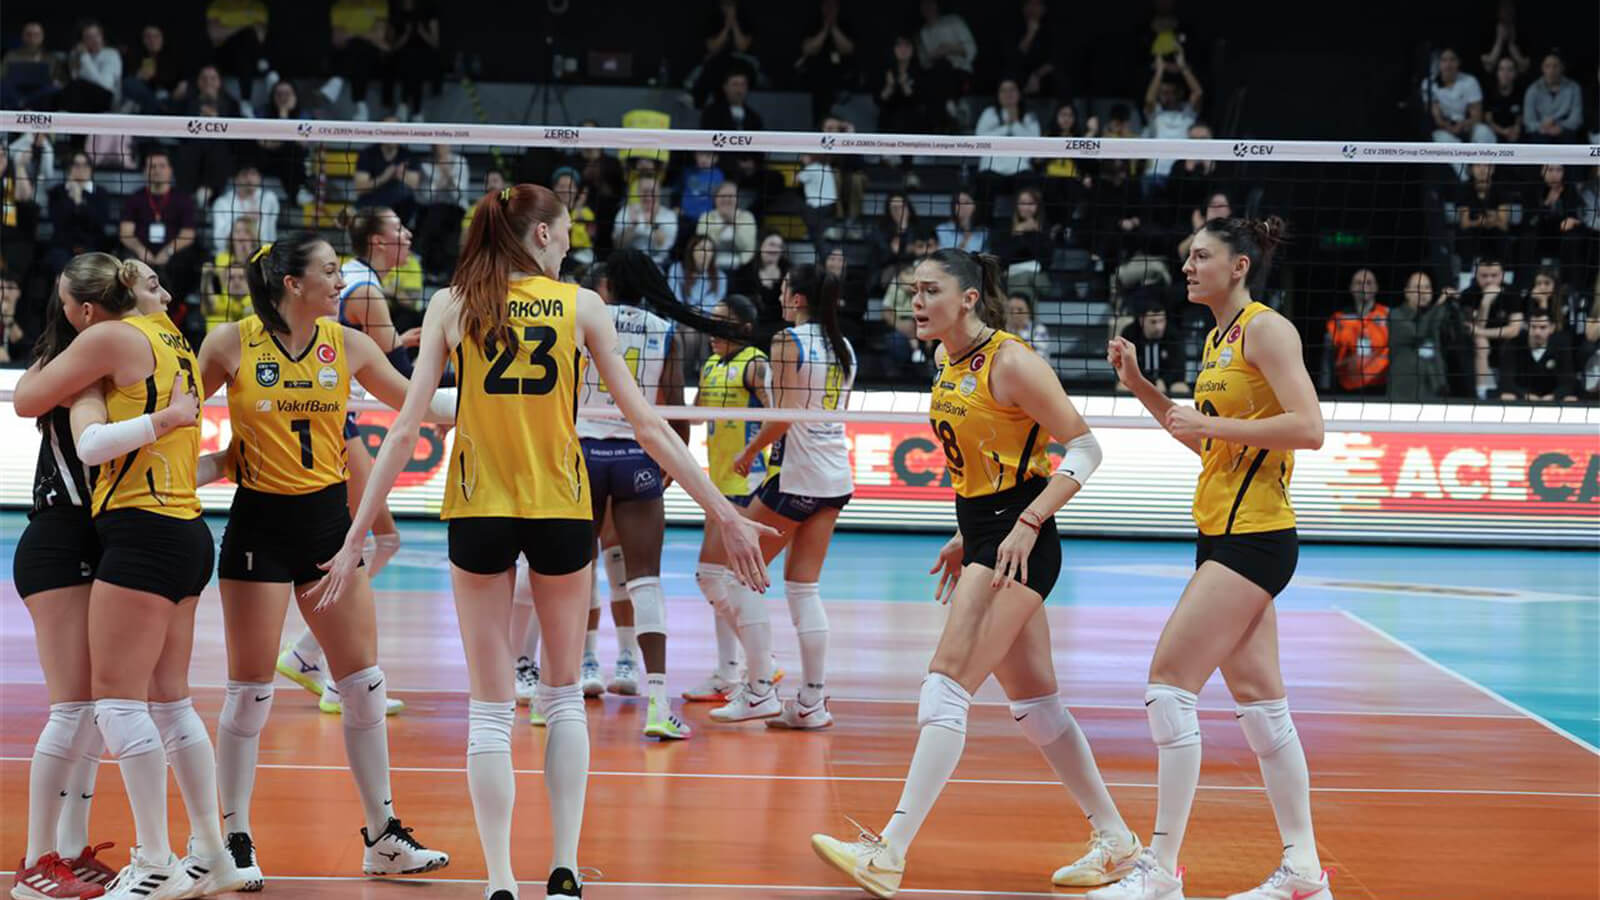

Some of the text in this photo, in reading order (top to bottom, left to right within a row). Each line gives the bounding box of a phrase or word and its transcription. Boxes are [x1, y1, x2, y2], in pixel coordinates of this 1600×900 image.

[16, 114, 52, 124] ZEREN
[205, 122, 228, 132] CEV
[544, 128, 580, 139] ZEREN
[729, 135, 753, 146] CEV
[1065, 139, 1101, 150] ZEREN
[1250, 145, 1274, 156] CEV
[506, 298, 564, 318] RKOVA
[484, 325, 559, 395] 23
[291, 419, 314, 470] 1
[245, 551, 254, 571] 1
